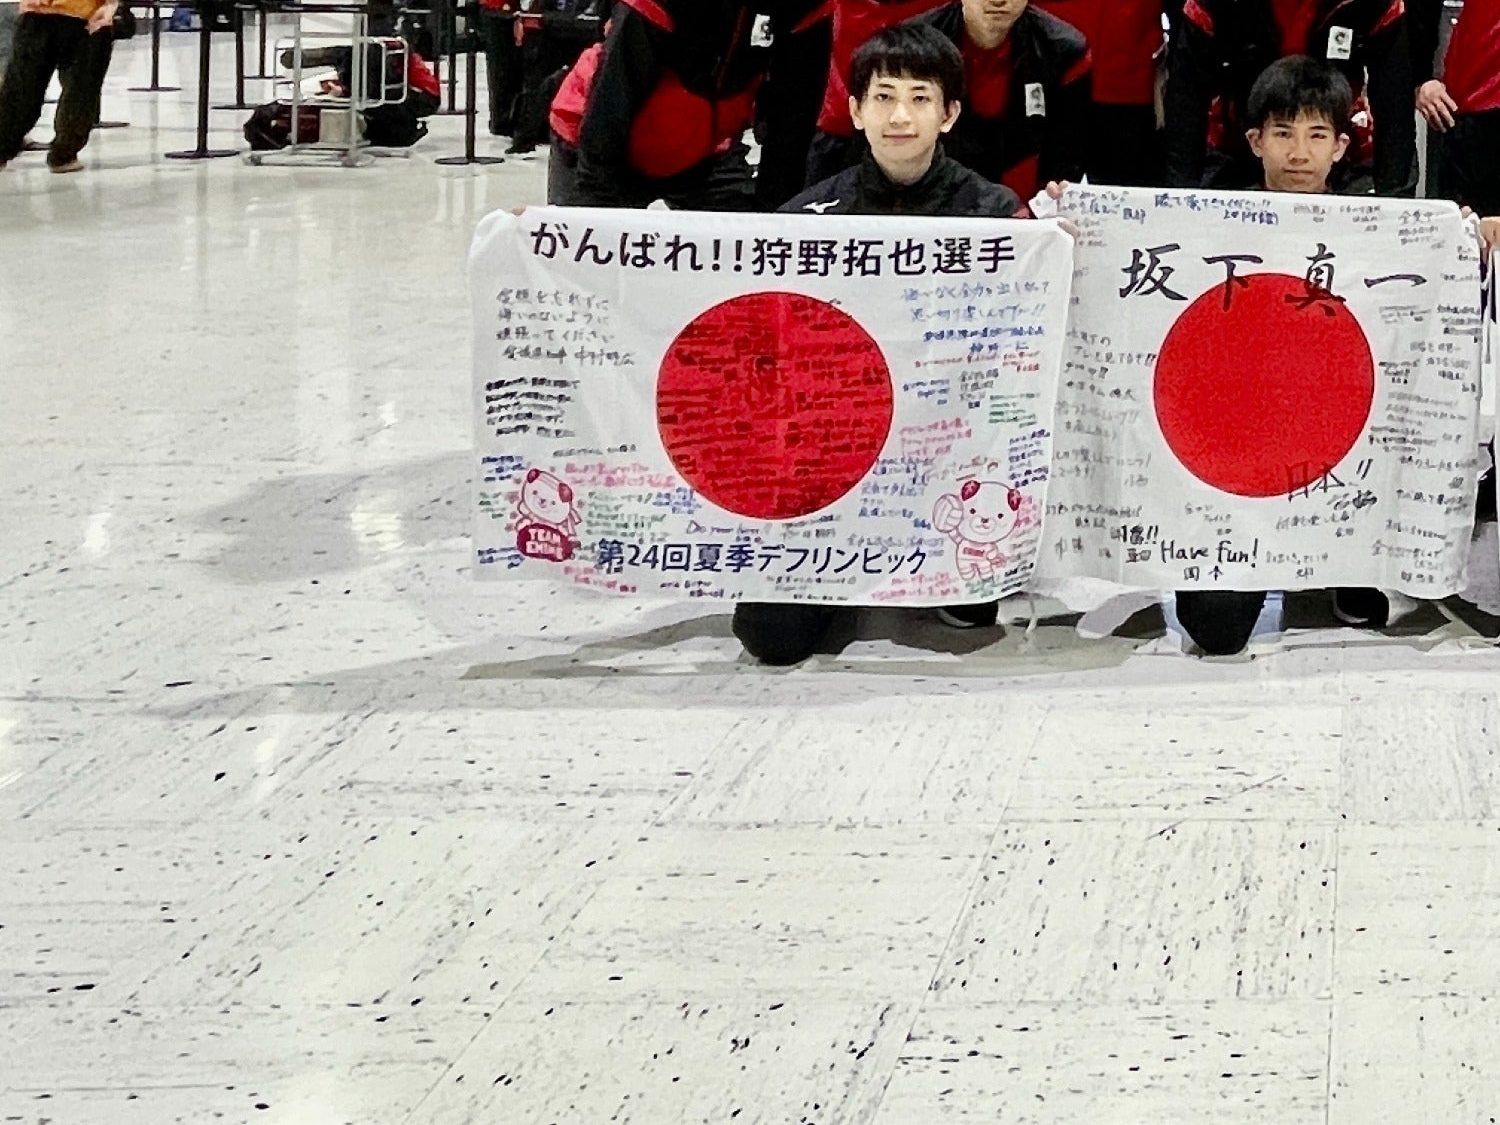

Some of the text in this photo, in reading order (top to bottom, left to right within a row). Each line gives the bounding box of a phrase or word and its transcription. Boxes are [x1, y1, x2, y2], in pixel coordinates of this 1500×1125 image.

[529, 221, 1016, 279] がんばれ!!狩野拓也選手
[1118, 242, 1428, 317] 坂下真一
[528, 527, 561, 544] TEAM
[1160, 537, 1259, 569] Have fun!
[597, 537, 927, 575] 第24回夏季デフリンピック
